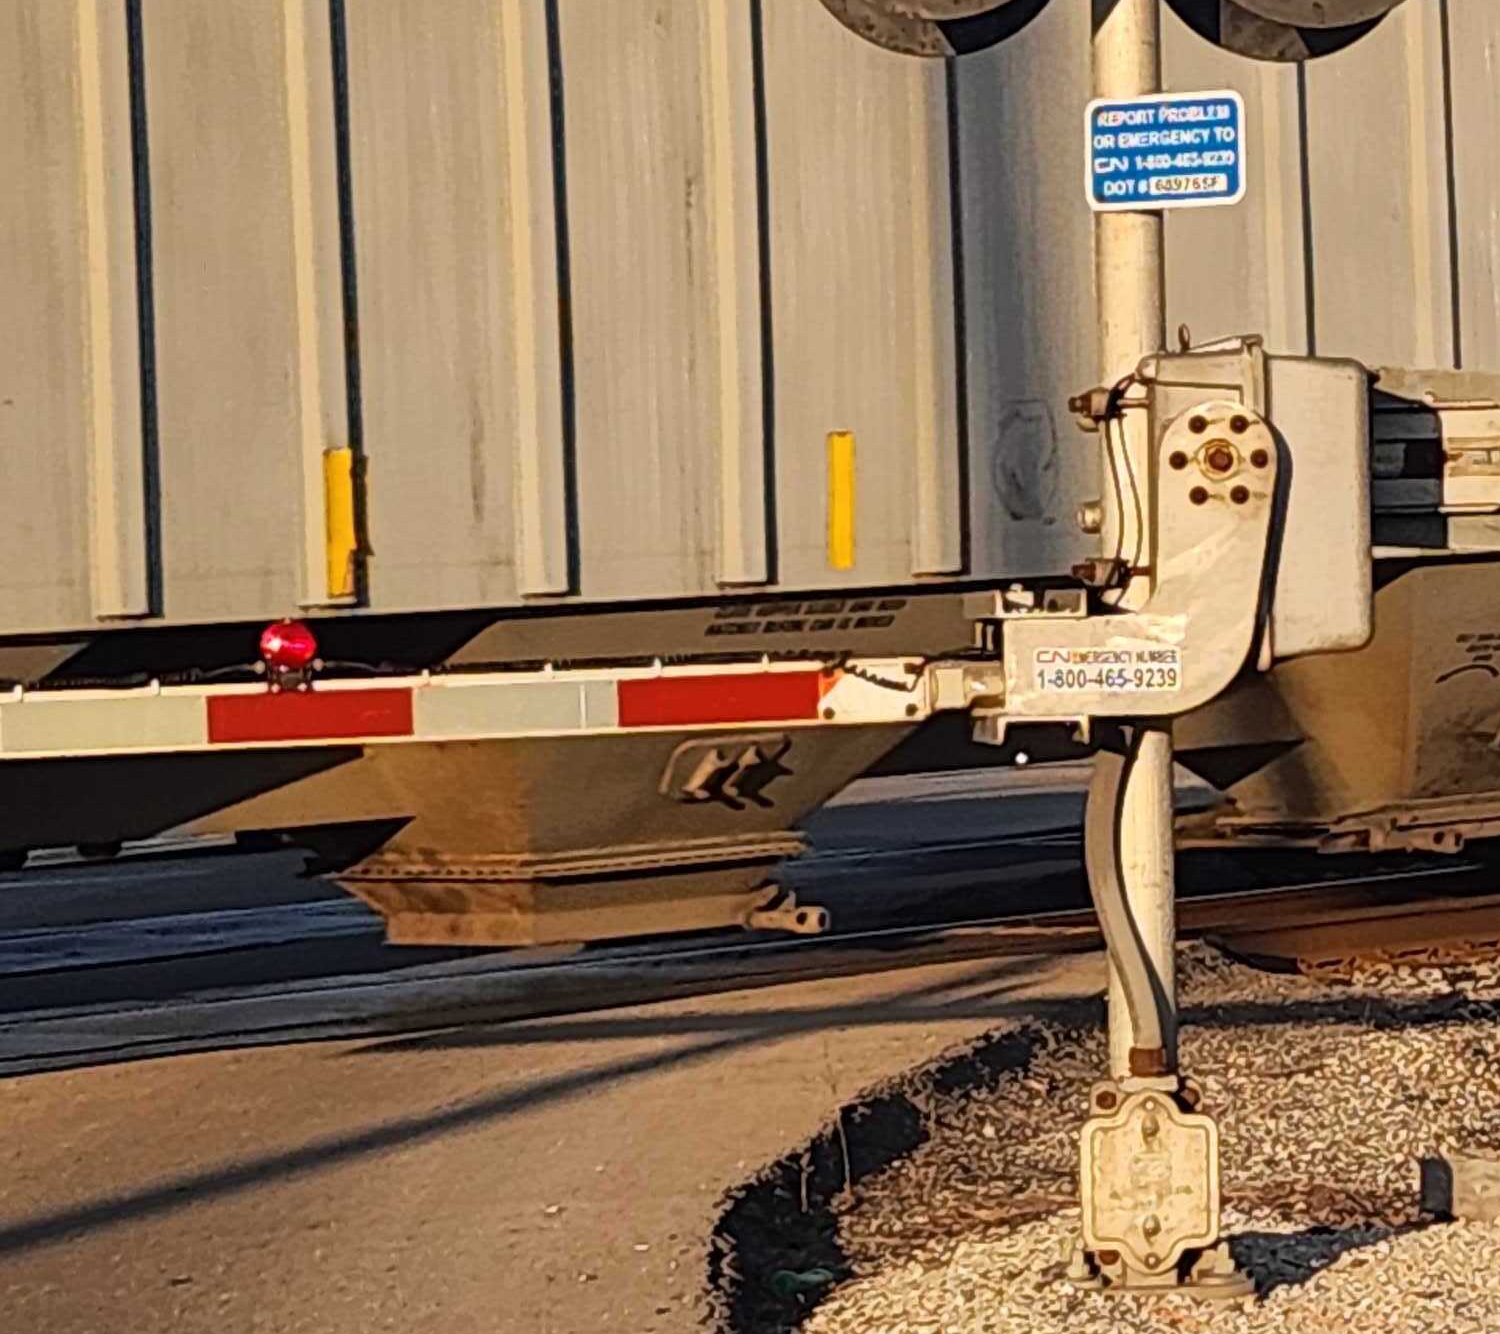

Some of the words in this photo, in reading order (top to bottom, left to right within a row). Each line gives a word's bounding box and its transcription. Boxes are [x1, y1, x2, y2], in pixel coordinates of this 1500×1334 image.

[1097, 109, 1155, 127] REPORT
[1094, 134, 1115, 149] OR
[1118, 128, 1210, 148] EMERGENCY
[1213, 126, 1235, 143] TO
[1094, 156, 1129, 173] CN
[1104, 179, 1135, 196] DOT
[1036, 651, 1070, 663] CN
[1037, 667, 1177, 689] 1-800-465-9239
